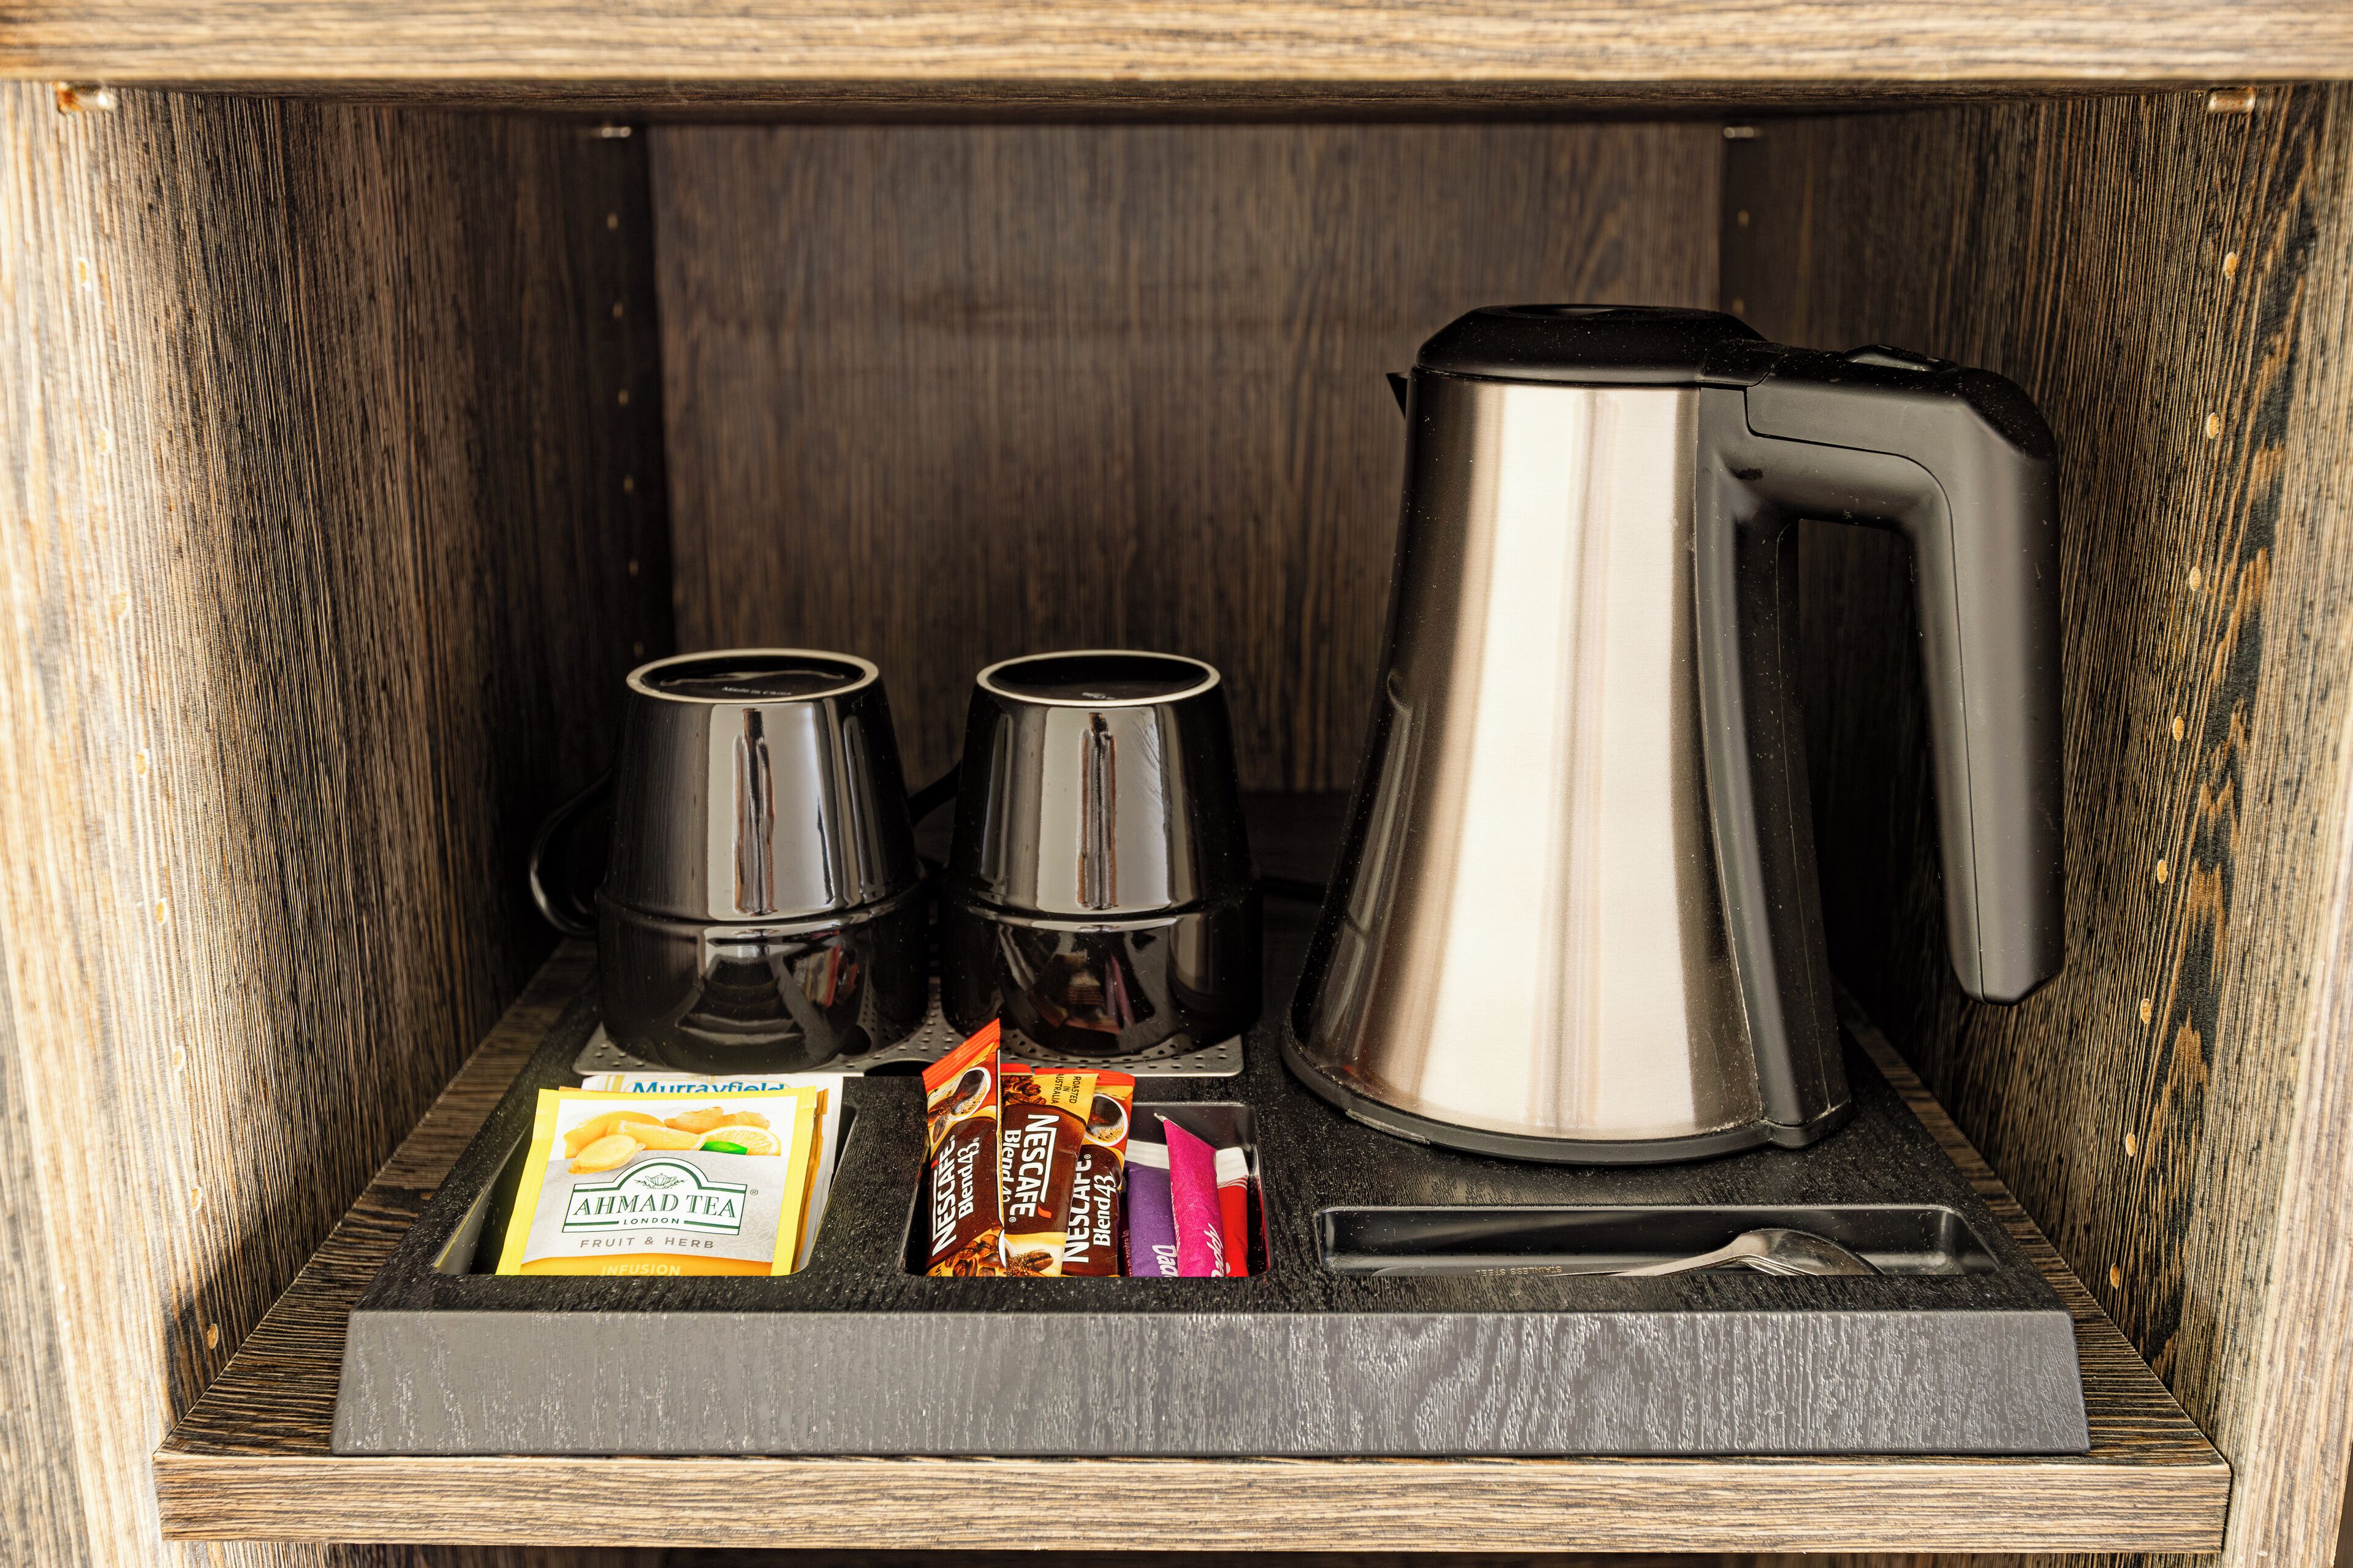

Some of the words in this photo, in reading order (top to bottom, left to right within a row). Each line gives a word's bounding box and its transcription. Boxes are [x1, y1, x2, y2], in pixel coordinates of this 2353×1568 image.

[1069, 1076, 1082, 1104] ROASTED
[573, 1194, 679, 1216] AHMAD
[686, 1195, 737, 1218] TEA
[580, 1237, 636, 1248] FRUIT
[644, 1237, 654, 1245] &
[664, 1237, 714, 1249] HERB
[601, 1263, 681, 1276] INFUSION
[1510, 1266, 1563, 1276] STAINLESS
